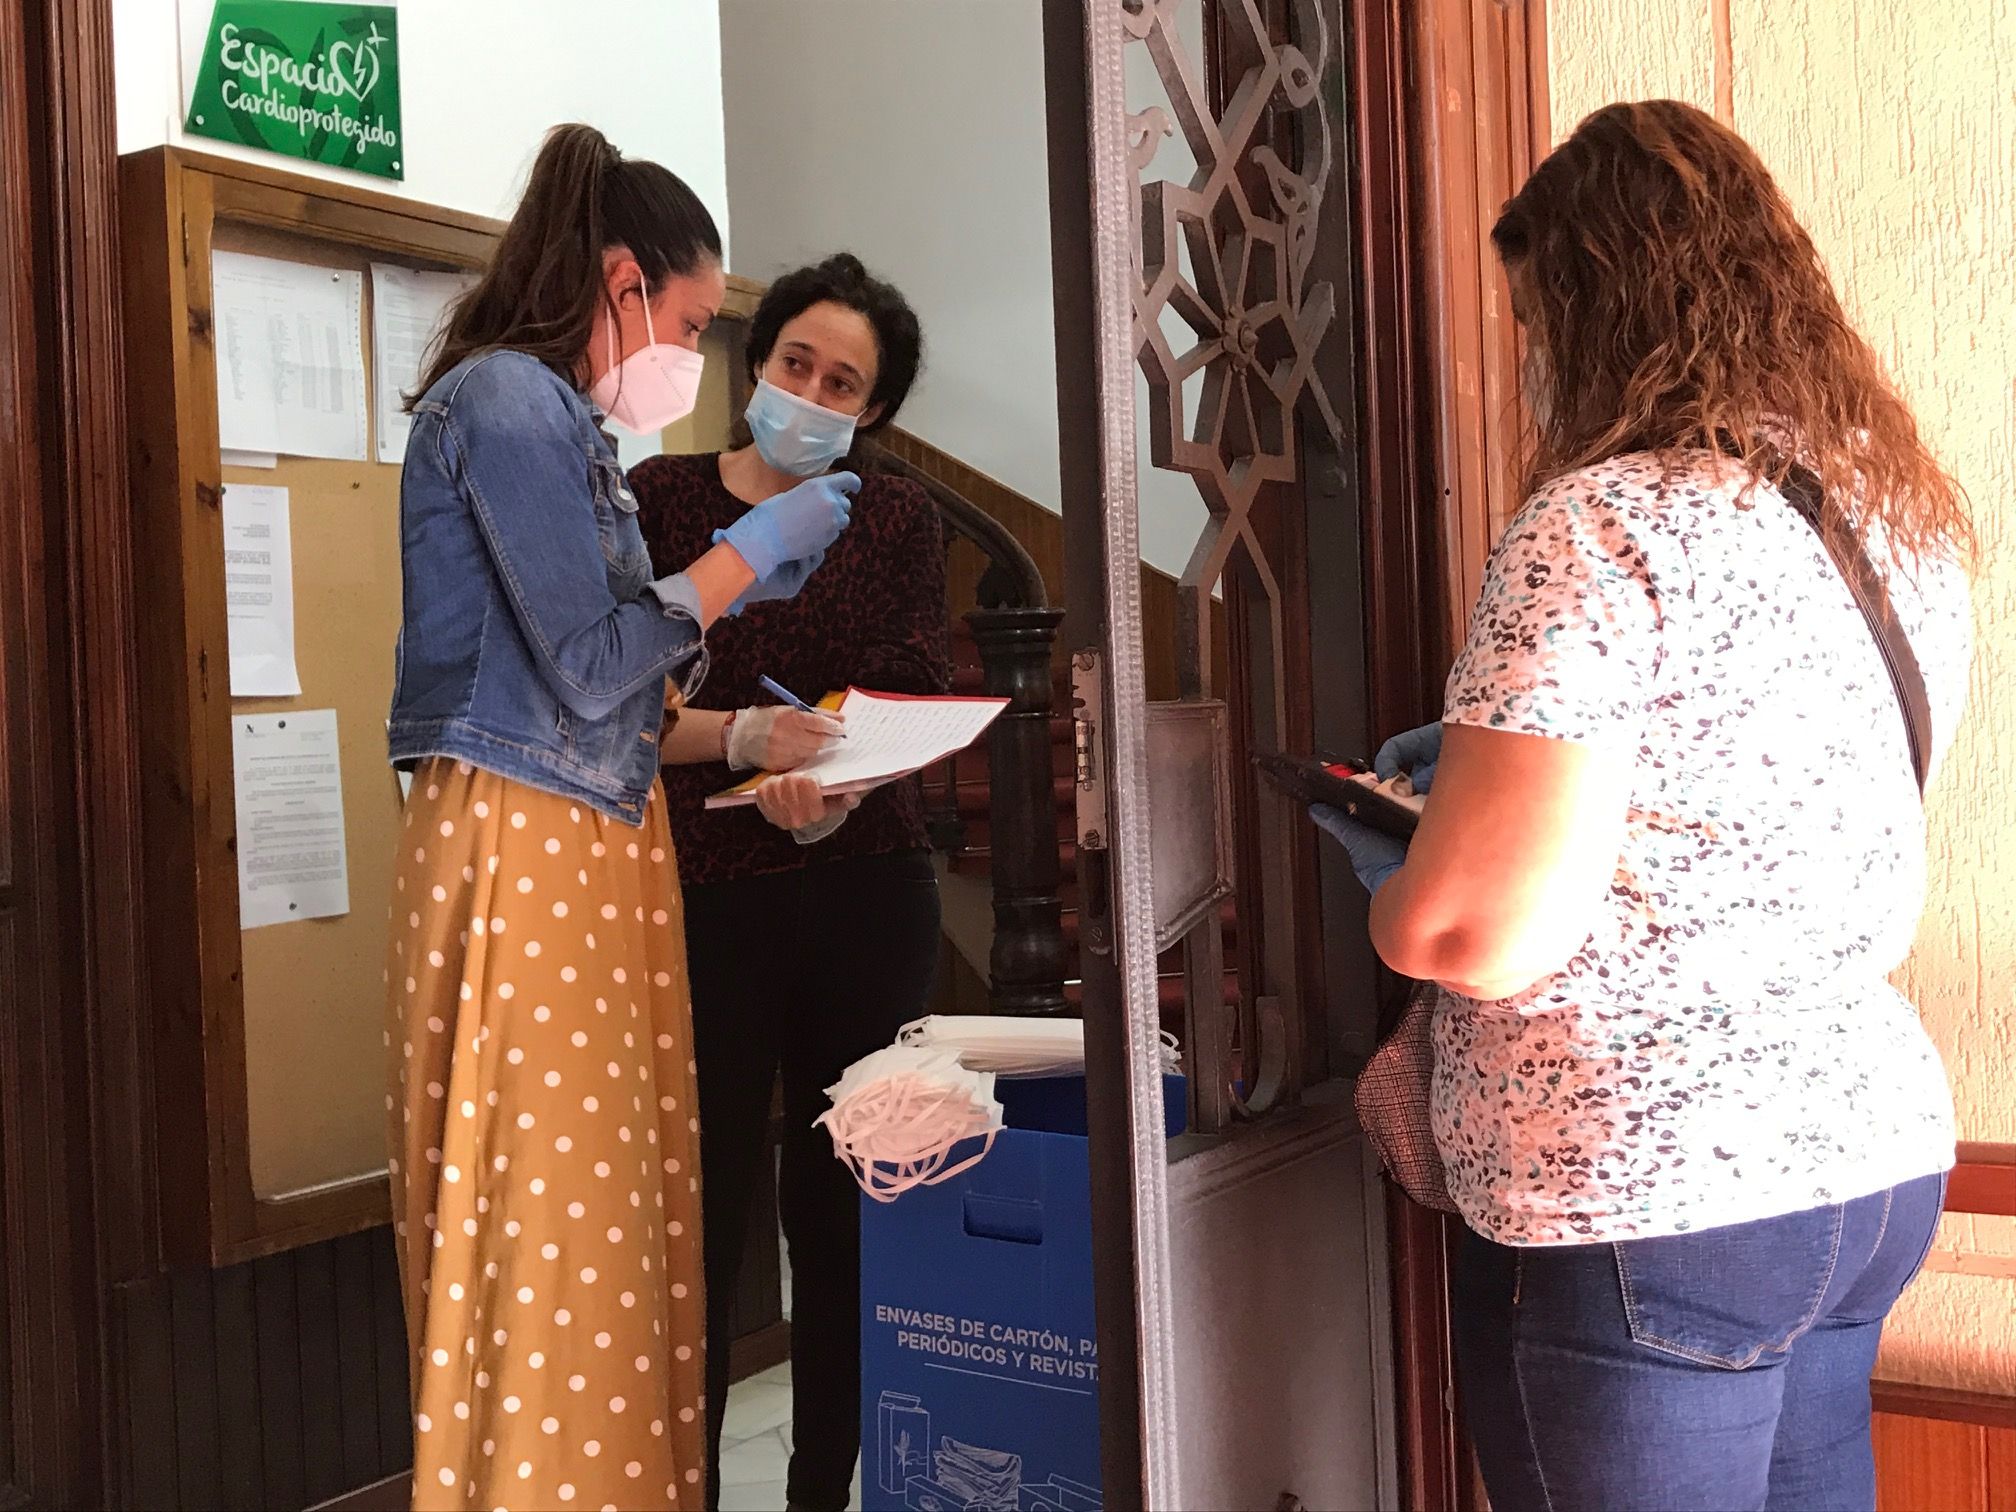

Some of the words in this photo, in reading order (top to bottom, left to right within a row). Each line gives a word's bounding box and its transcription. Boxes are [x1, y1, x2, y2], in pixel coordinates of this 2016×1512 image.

[220, 23, 347, 97] Espacio
[222, 79, 396, 154] Cardioprotegido
[875, 1304, 956, 1334] ENVASES
[960, 1318, 986, 1339] DE
[989, 1323, 1074, 1357] CARTÓN,
[897, 1330, 1008, 1366] PERIÓDICOS
[1011, 1350, 1025, 1368] Y
[1029, 1353, 1099, 1382] REVIST
